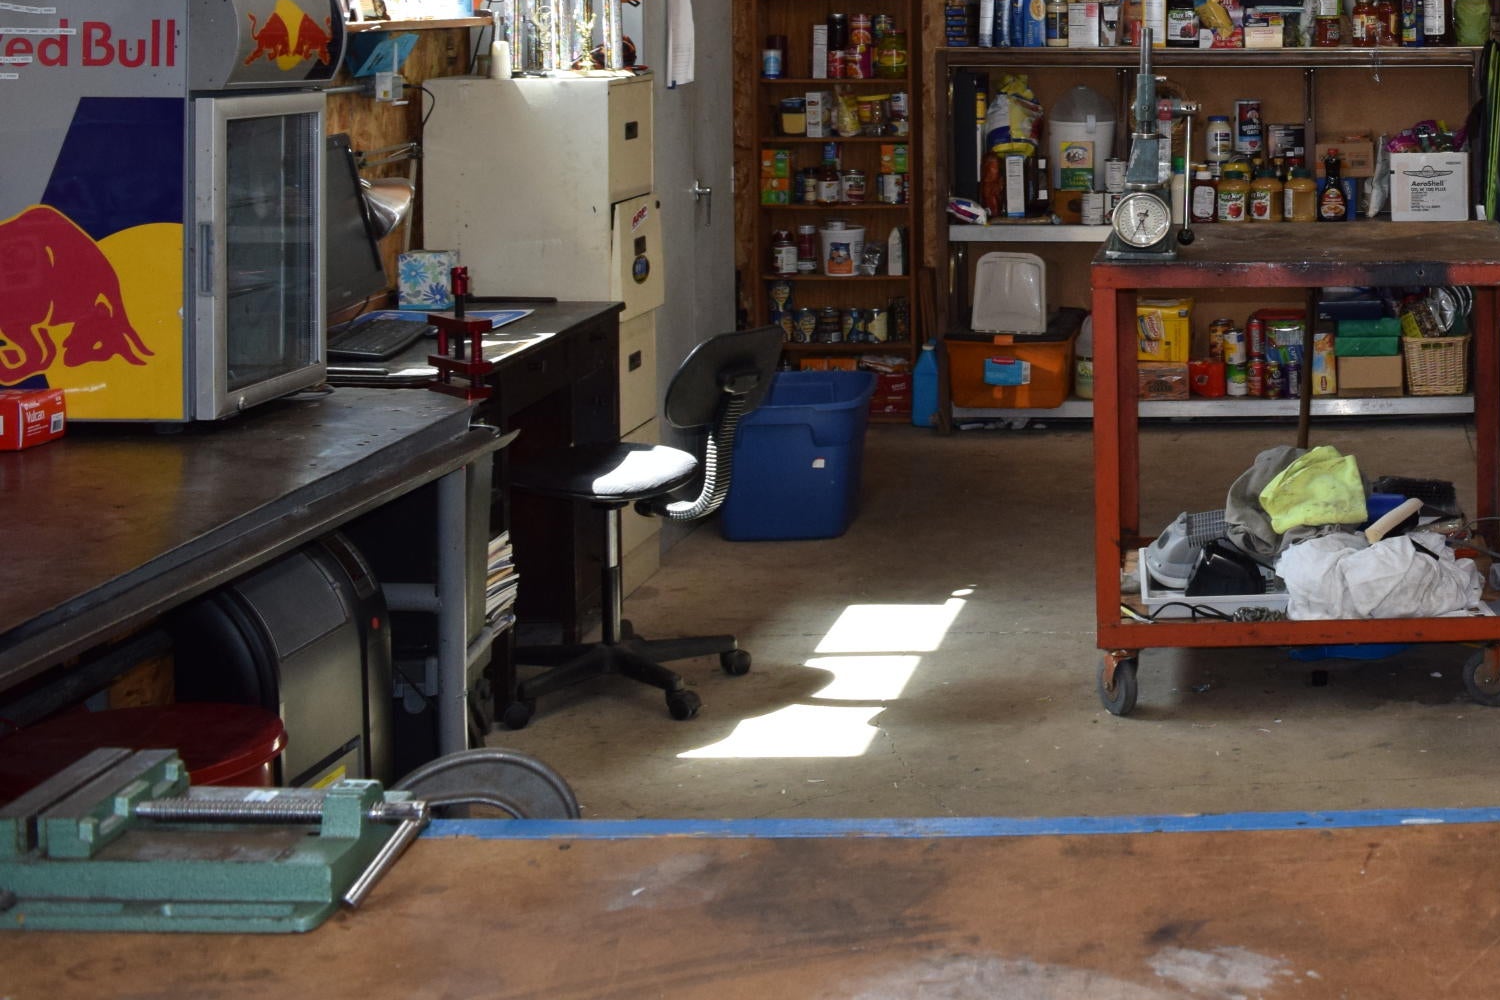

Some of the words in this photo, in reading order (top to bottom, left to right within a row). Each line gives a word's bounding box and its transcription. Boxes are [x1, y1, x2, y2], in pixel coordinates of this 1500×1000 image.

[0, 18, 68, 67] ed
[82, 18, 176, 68] Bull
[1411, 179, 1445, 187] AeroShell
[26, 410, 46, 424] Vulcan
